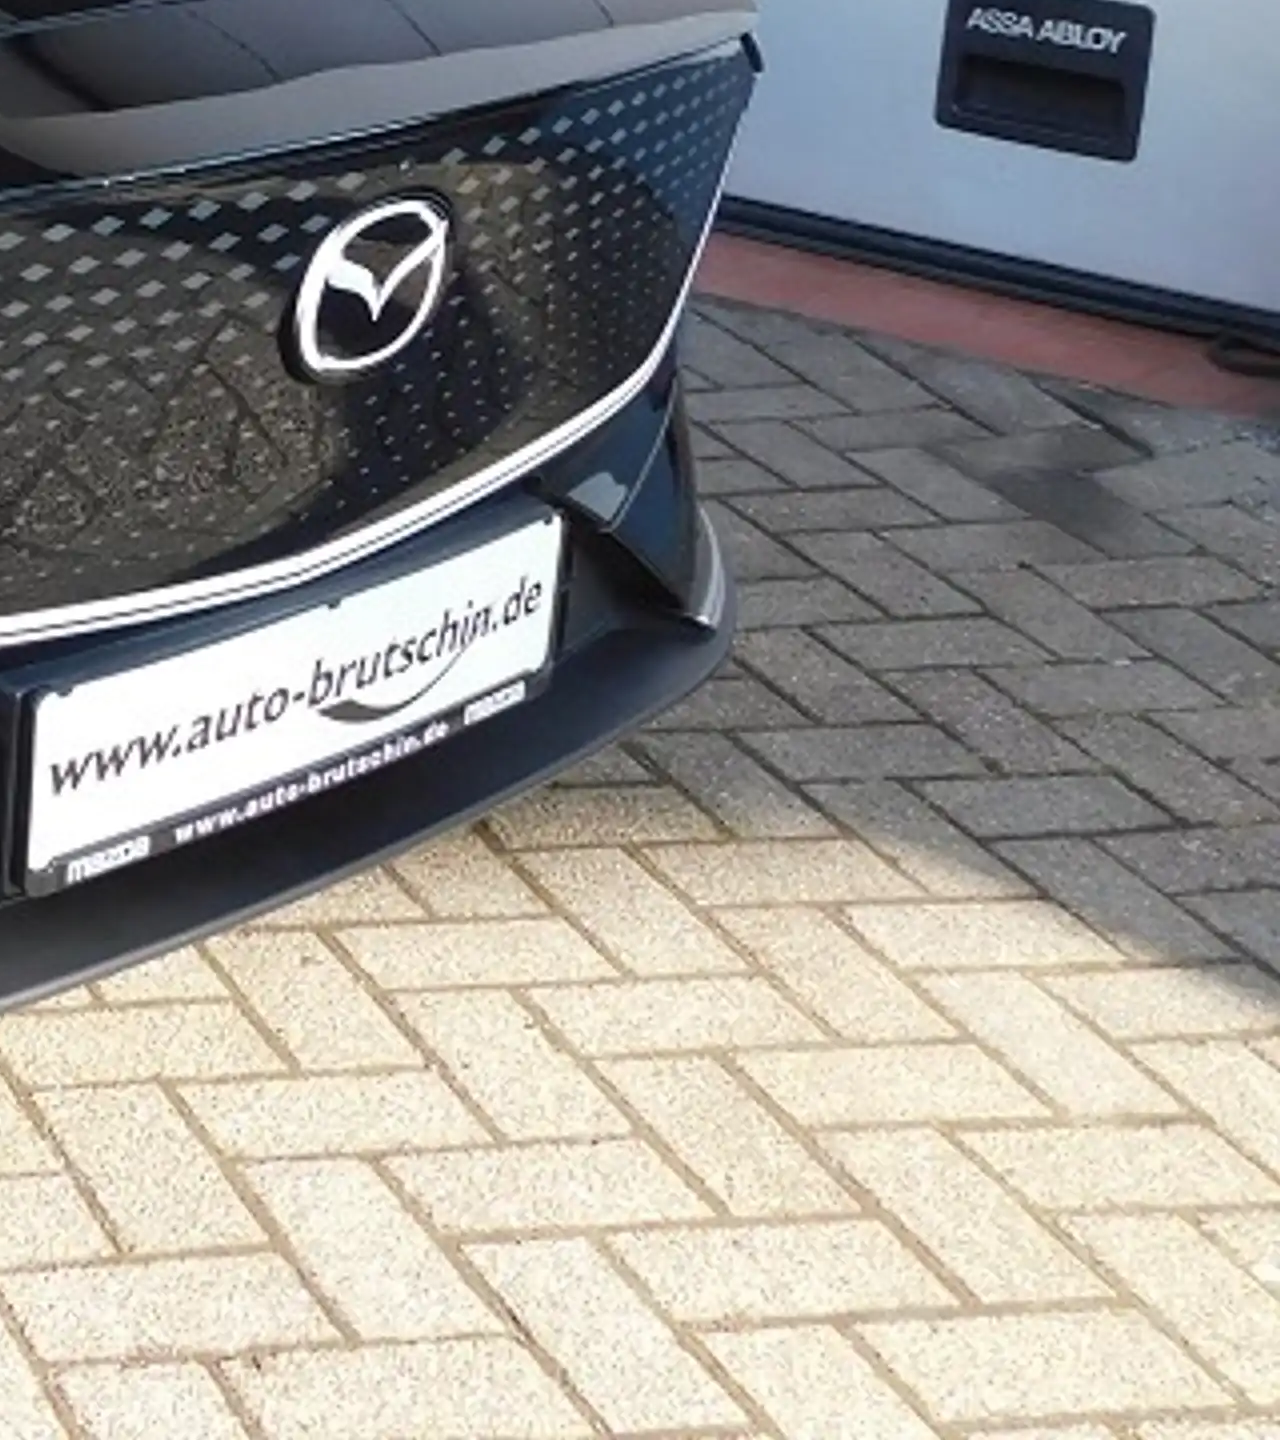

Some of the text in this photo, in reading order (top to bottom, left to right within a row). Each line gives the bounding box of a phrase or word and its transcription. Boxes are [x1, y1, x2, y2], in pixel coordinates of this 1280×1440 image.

[966, 8, 1127, 53] ASSA ABLOY
[47, 574, 543, 798] www.auto-brutschin.de
[174, 720, 449, 844] www.auto-brutschin.de
